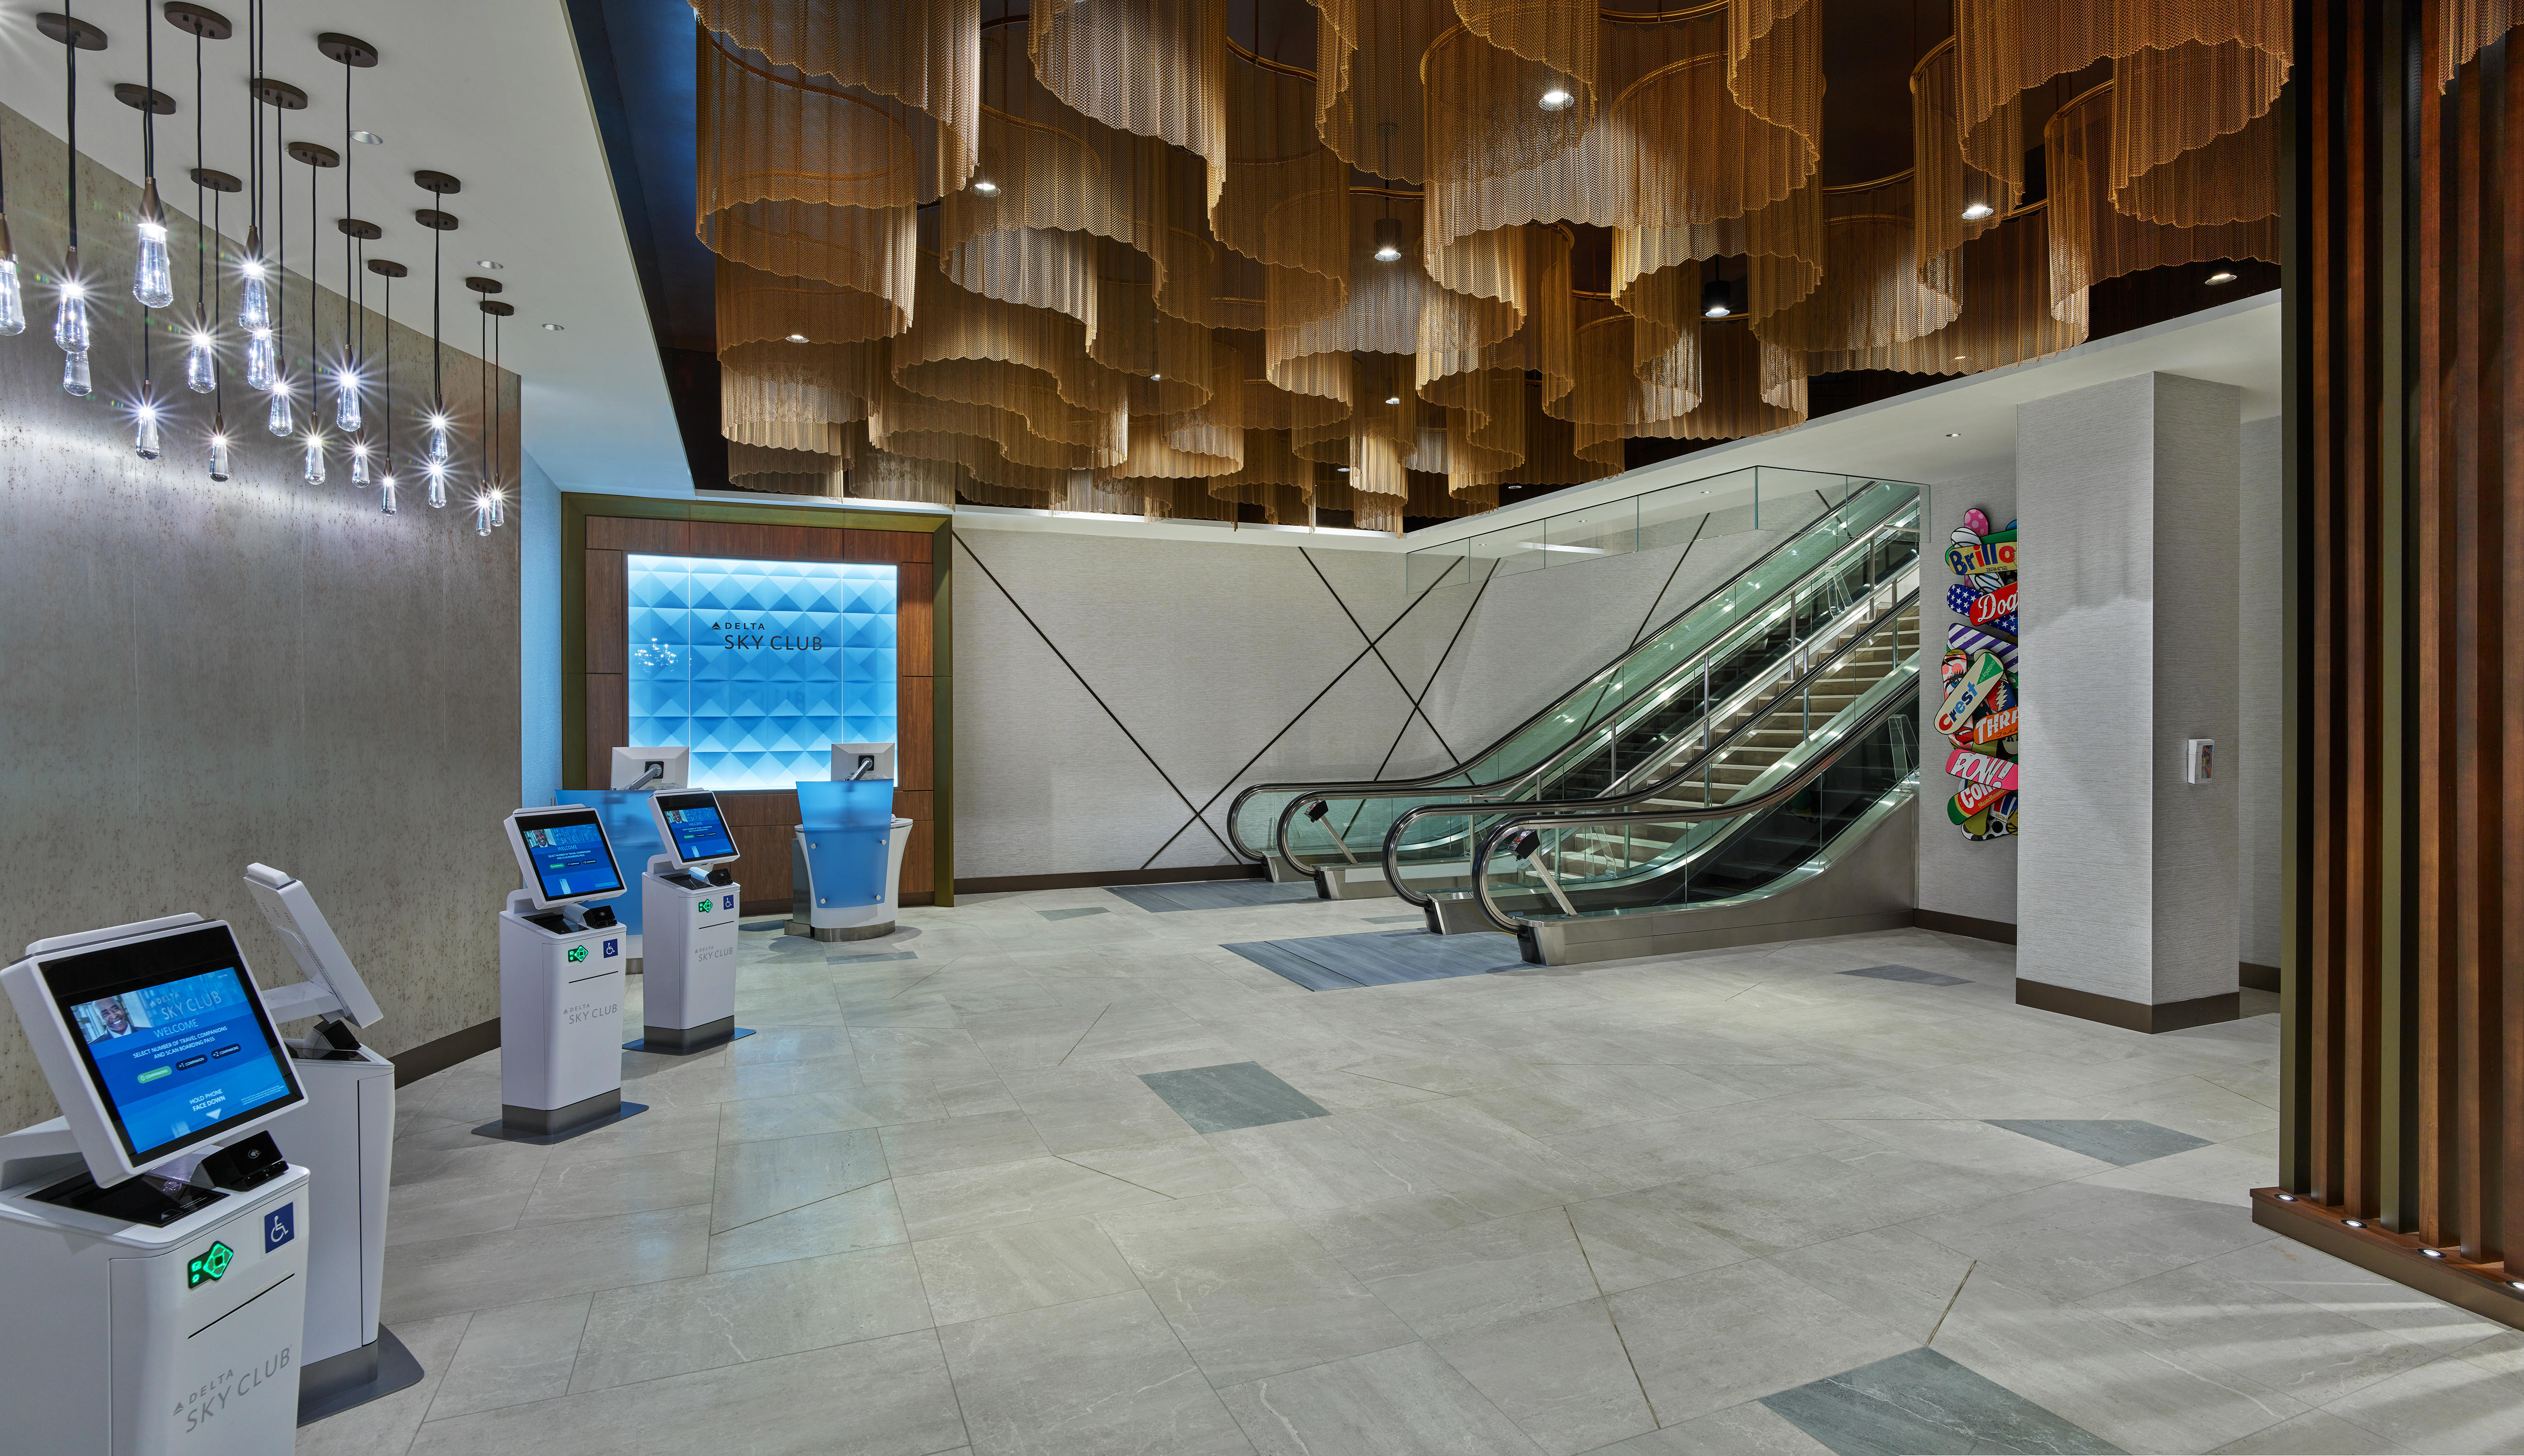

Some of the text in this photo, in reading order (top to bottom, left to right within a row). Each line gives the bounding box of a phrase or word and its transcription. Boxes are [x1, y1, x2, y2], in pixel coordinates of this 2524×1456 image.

[1949, 544, 2015, 575] Brillo
[725, 635, 822, 651] SKY CLUB
[1939, 681, 1978, 731] Crest
[1950, 752, 2014, 789] POW!
[699, 947, 733, 961] SKY CLUB
[156, 992, 180, 1005] DELTA
[161, 991, 221, 1020] SKY CLUB
[570, 1003, 590, 1012] DELTA
[569, 1004, 617, 1024] SKY CLUB
[153, 1019, 199, 1038] WELCOME
[133, 1049, 151, 1059] SELECT
[151, 1043, 172, 1053] NUMBER
[180, 1035, 197, 1044] TRAVEL
[197, 1026, 227, 1039] COMPANIONS
[180, 1041, 204, 1051] BOARDING
[189, 1089, 223, 1105] HOLD PHONE
[192, 1095, 226, 1111] FACE DOWN
[186, 1347, 290, 1433] SKY CLUB
[189, 1369, 234, 1405] DELTA
